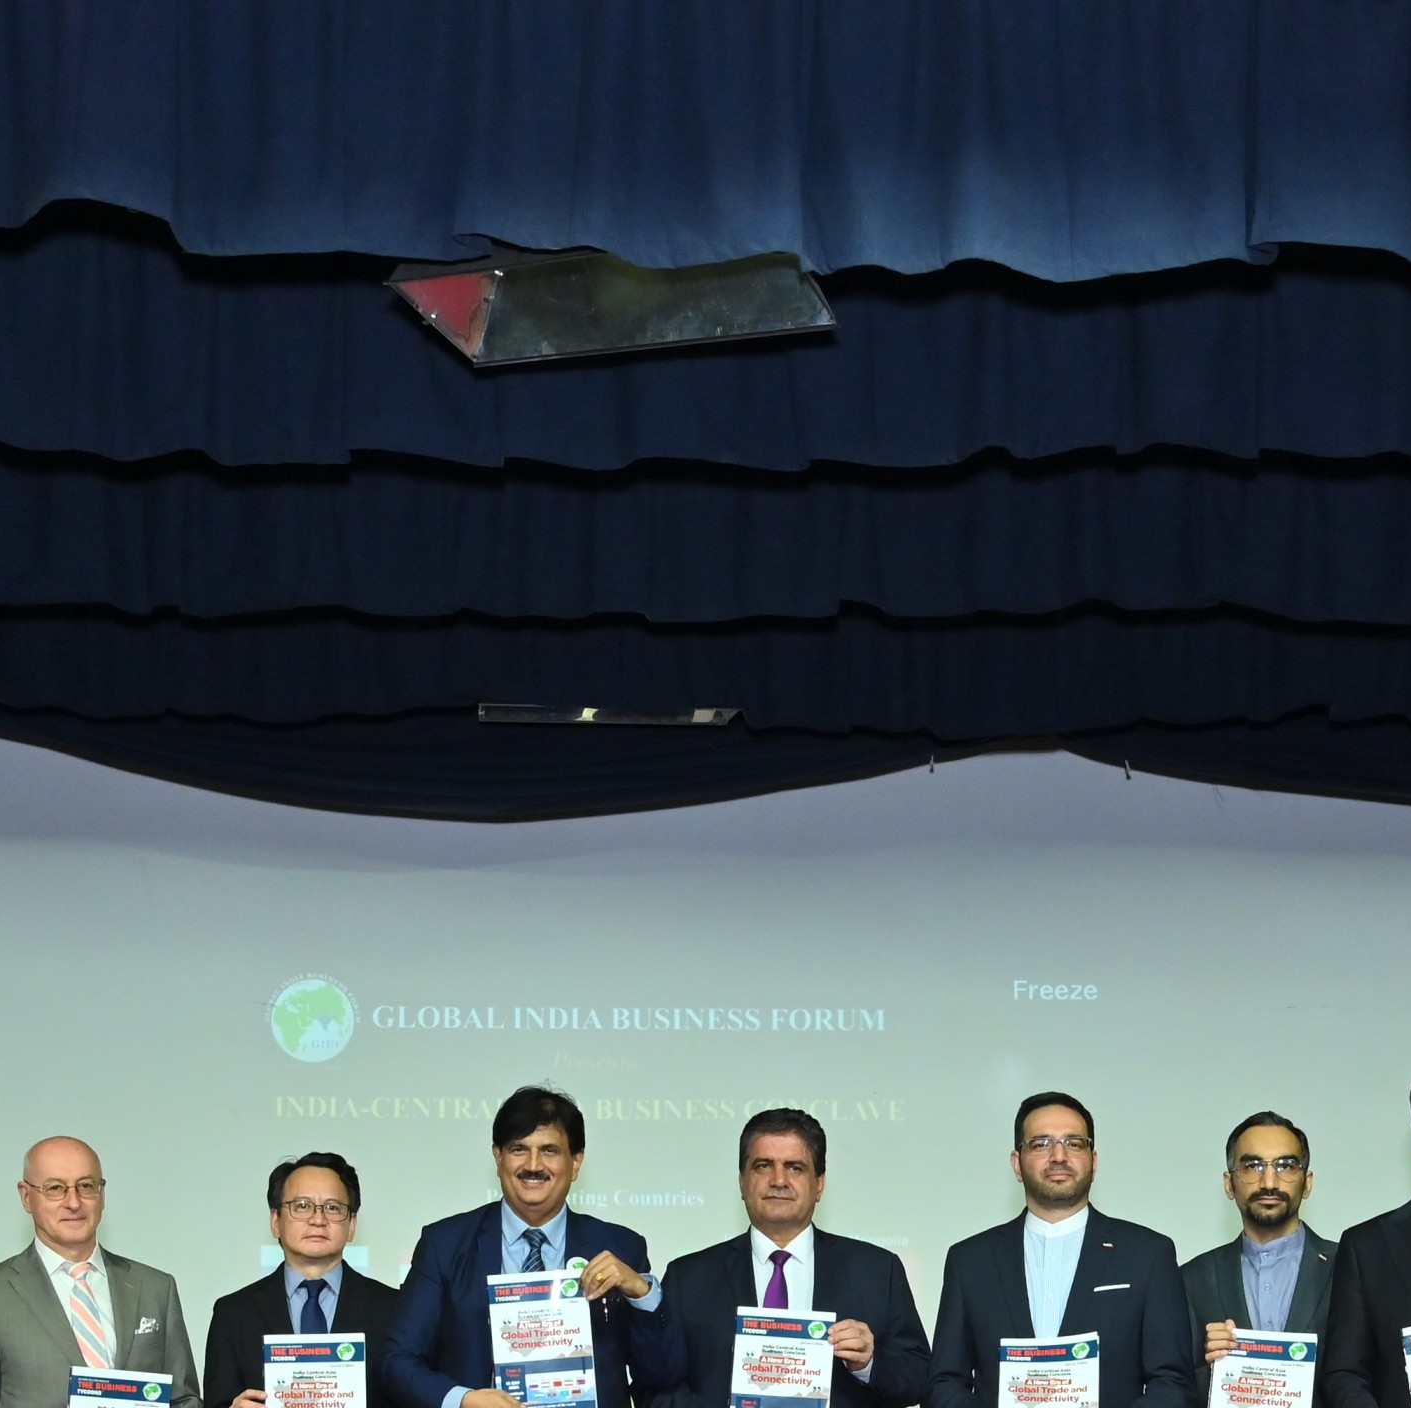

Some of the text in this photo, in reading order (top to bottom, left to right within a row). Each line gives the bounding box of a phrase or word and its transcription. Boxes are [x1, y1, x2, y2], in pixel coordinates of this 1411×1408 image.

[1014, 980, 1098, 1000] Freeze
[372, 1005, 886, 1031] GLOBAL INDIA BUSINESS FORUM
[596, 1099, 735, 1120] BUSINESS
[613, 1189, 705, 1205] Countries
[761, 1322, 802, 1331] BUSINESS
[501, 1327, 580, 1339] Global Trade and
[512, 1337, 572, 1349] Connectivity
[1241, 1344, 1283, 1353] BUSINESS
[742, 1363, 773, 1372] Global
[775, 1366, 802, 1374] Trade
[751, 1374, 812, 1386] Connectivity
[78, 1381, 137, 1392] THE BUSINESS
[1221, 1384, 1252, 1393] Global
[1255, 1387, 1282, 1396] Trade
[275, 1391, 305, 1399] Global
[1018, 1395, 1079, 1403] Connectivity
[285, 1401, 346, 1408] Connectivity
[1230, 1395, 1292, 1408] Connectivity
